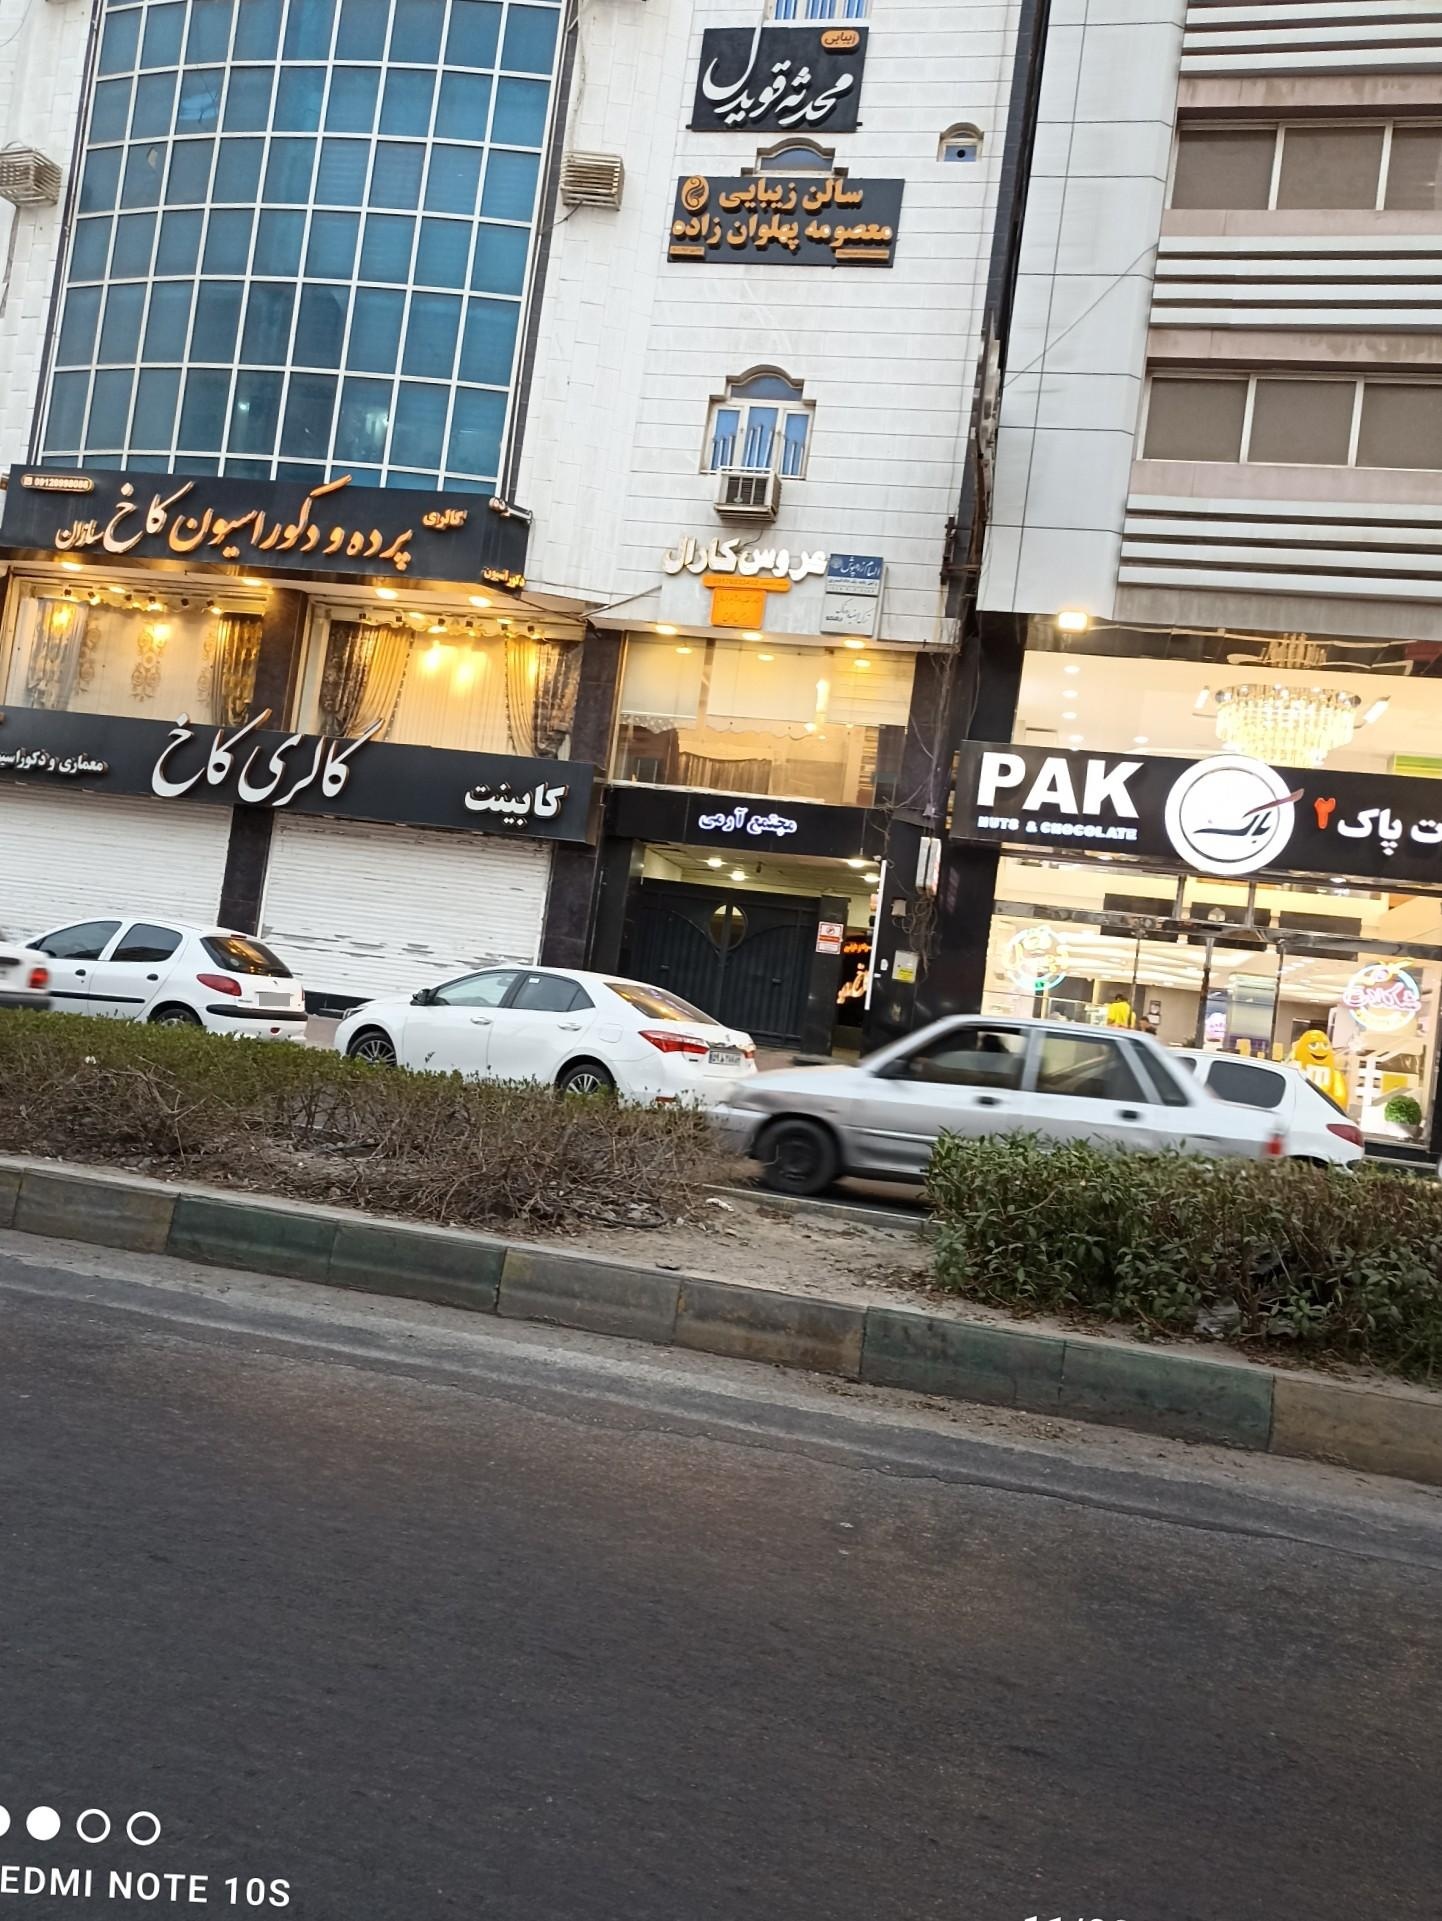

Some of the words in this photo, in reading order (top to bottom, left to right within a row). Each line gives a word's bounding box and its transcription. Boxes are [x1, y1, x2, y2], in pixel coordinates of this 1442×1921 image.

[775, 66, 854, 125] محدثه
[718, 178, 798, 209] زیبایی
[802, 178, 864, 210] سالن
[672, 213, 722, 244] زاده
[726, 213, 800, 250] پهلوان
[804, 219, 894, 247] معصومه
[102, 480, 195, 554] کاخ
[168, 474, 353, 559] دکوراسیون
[322, 526, 346, 555] و
[344, 528, 414, 572] پرده
[738, 548, 828, 582] عروس
[47, 757, 59, 771] و
[58, 753, 108, 774] معماری
[151, 707, 273, 797] کاخ
[976, 751, 1144, 819] PAK
[464, 781, 568, 826] کابینت
[746, 813, 798, 837] مجتمع
[977, 815, 1020, 831] NUTS
[1025, 820, 1038, 833] &
[1039, 821, 1138, 841] CHOCOLATE
[1337, 808, 1403, 856] پاک
